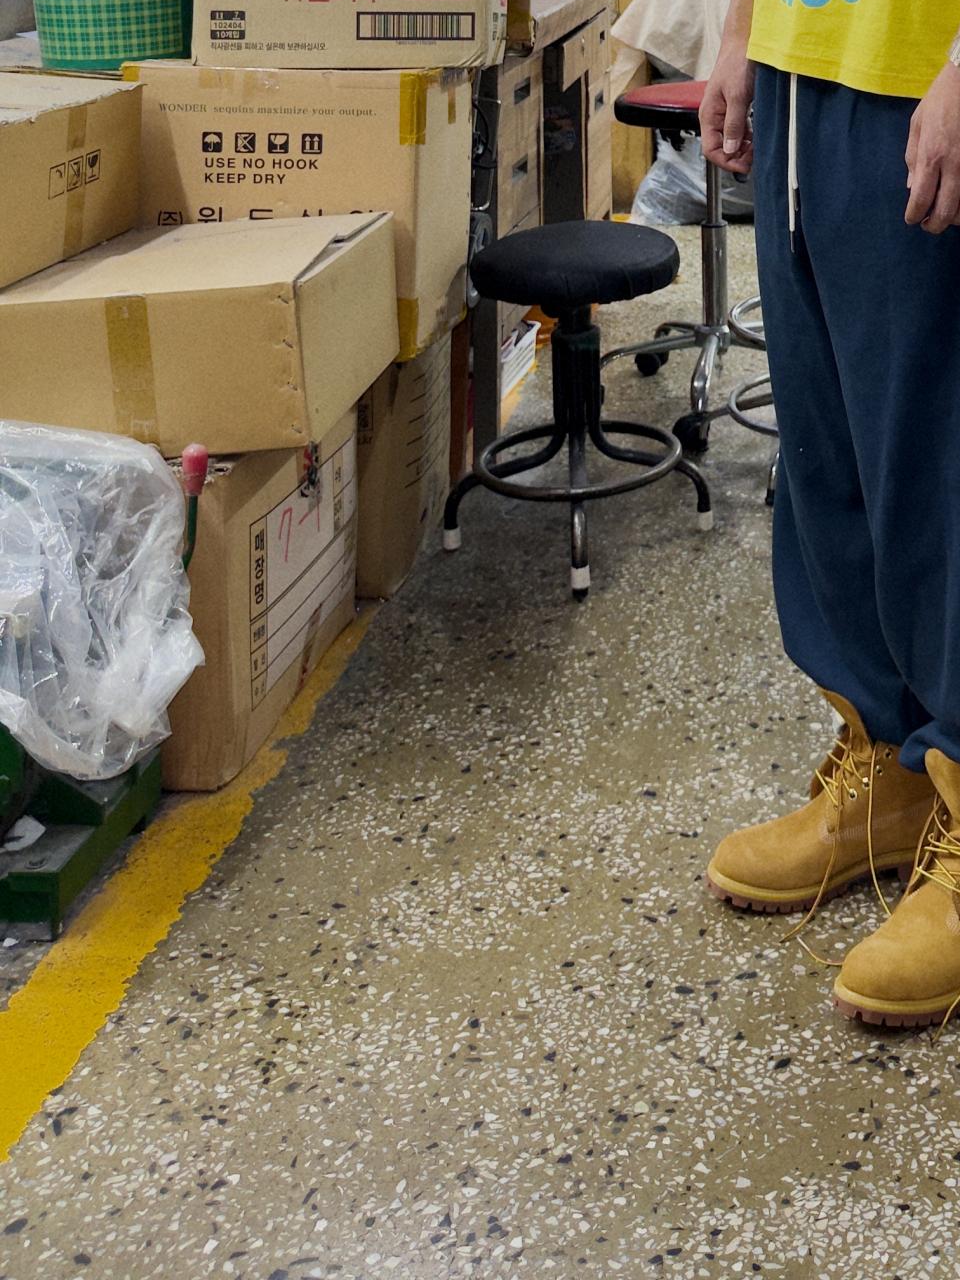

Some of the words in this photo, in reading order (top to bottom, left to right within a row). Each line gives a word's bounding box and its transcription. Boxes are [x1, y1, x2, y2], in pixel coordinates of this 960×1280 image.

[159, 103, 207, 113] WONDER
[213, 104, 254, 116] sequins
[257, 104, 308, 114] maximize
[312, 106, 335, 117] your
[204, 157, 236, 169] USE
[243, 158, 265, 170] NO
[272, 158, 319, 170] HOOK
[204, 173, 246, 184] KEEP
[253, 173, 286, 185] DRY
